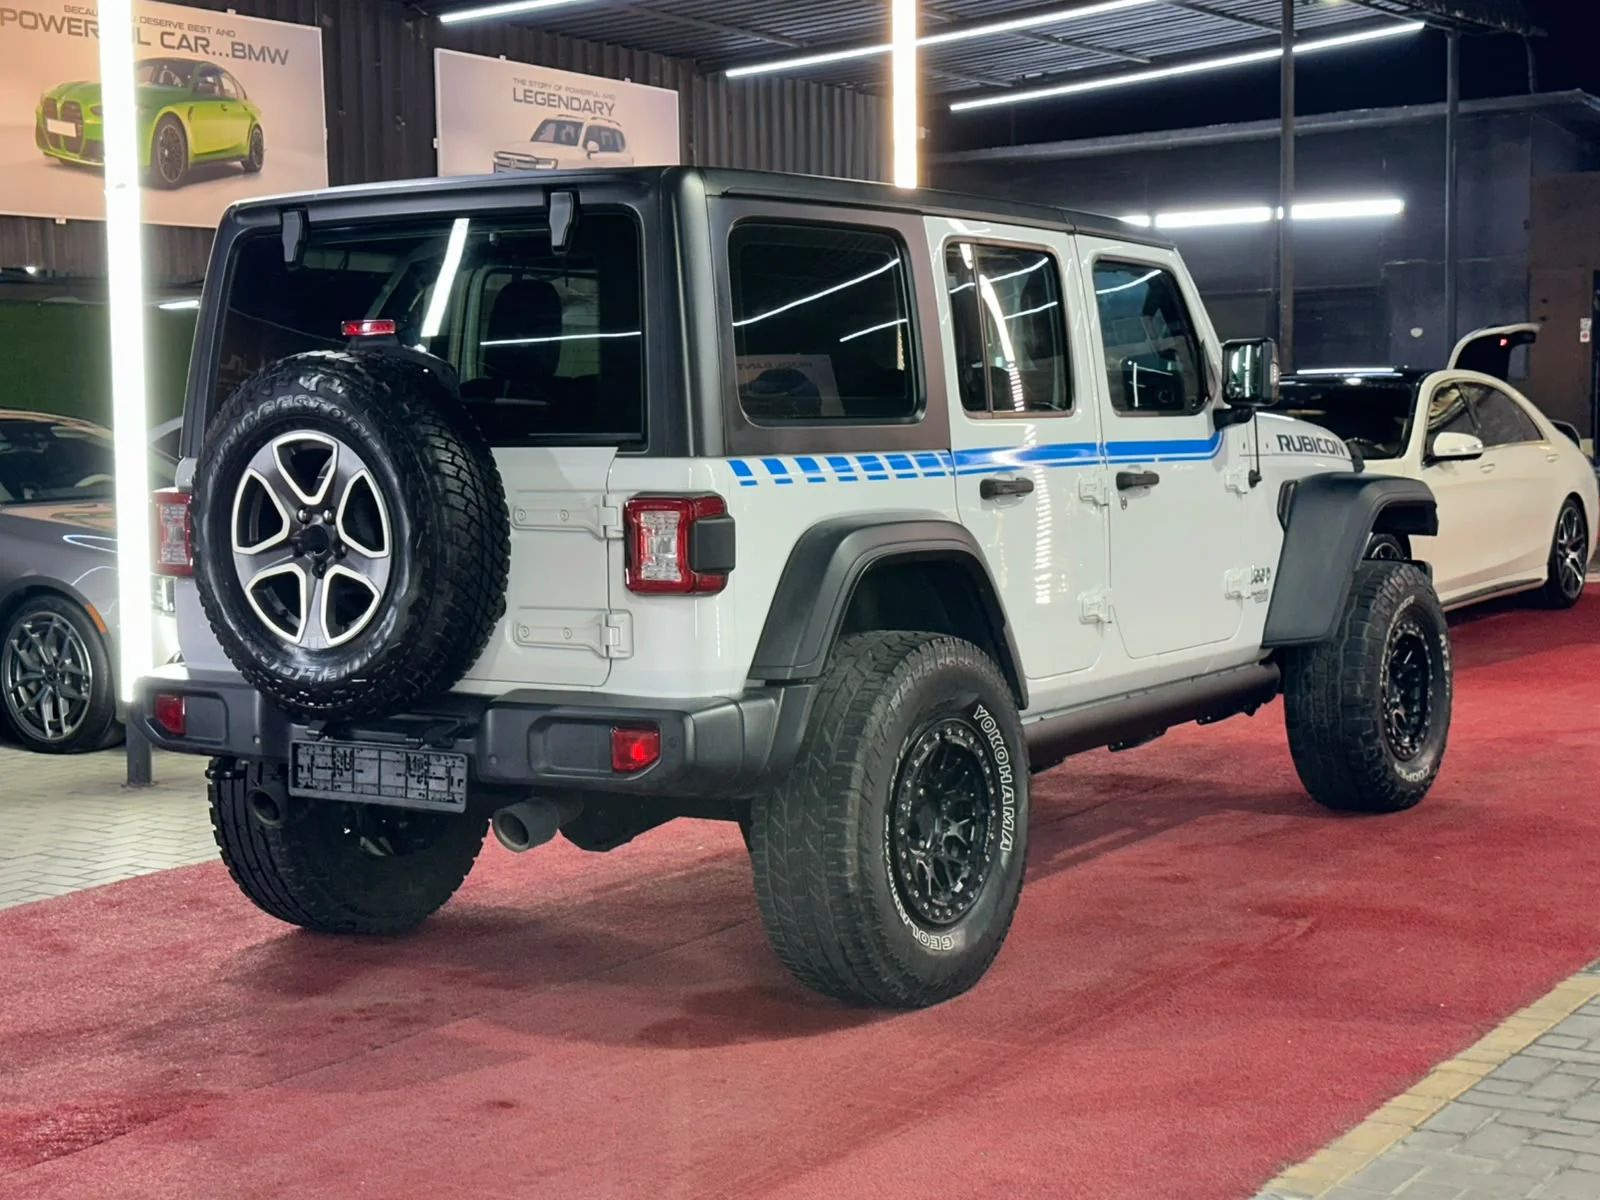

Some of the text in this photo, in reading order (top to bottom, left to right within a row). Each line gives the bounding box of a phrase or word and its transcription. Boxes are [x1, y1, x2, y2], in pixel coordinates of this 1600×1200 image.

[0, 7, 151, 47] POWERL
[64, 4, 98, 17] BECAU
[139, 16, 184, 30] DESERVE
[187, 23, 213, 34] BEST
[215, 27, 236, 38] AND
[512, 77, 527, 86] THE
[528, 79, 552, 90] STORY
[553, 84, 563, 92] OF
[512, 87, 615, 117] LEGENDARY
[1276, 434, 1346, 457] RUBICON
[972, 703, 1016, 852] YOKOHAMA
